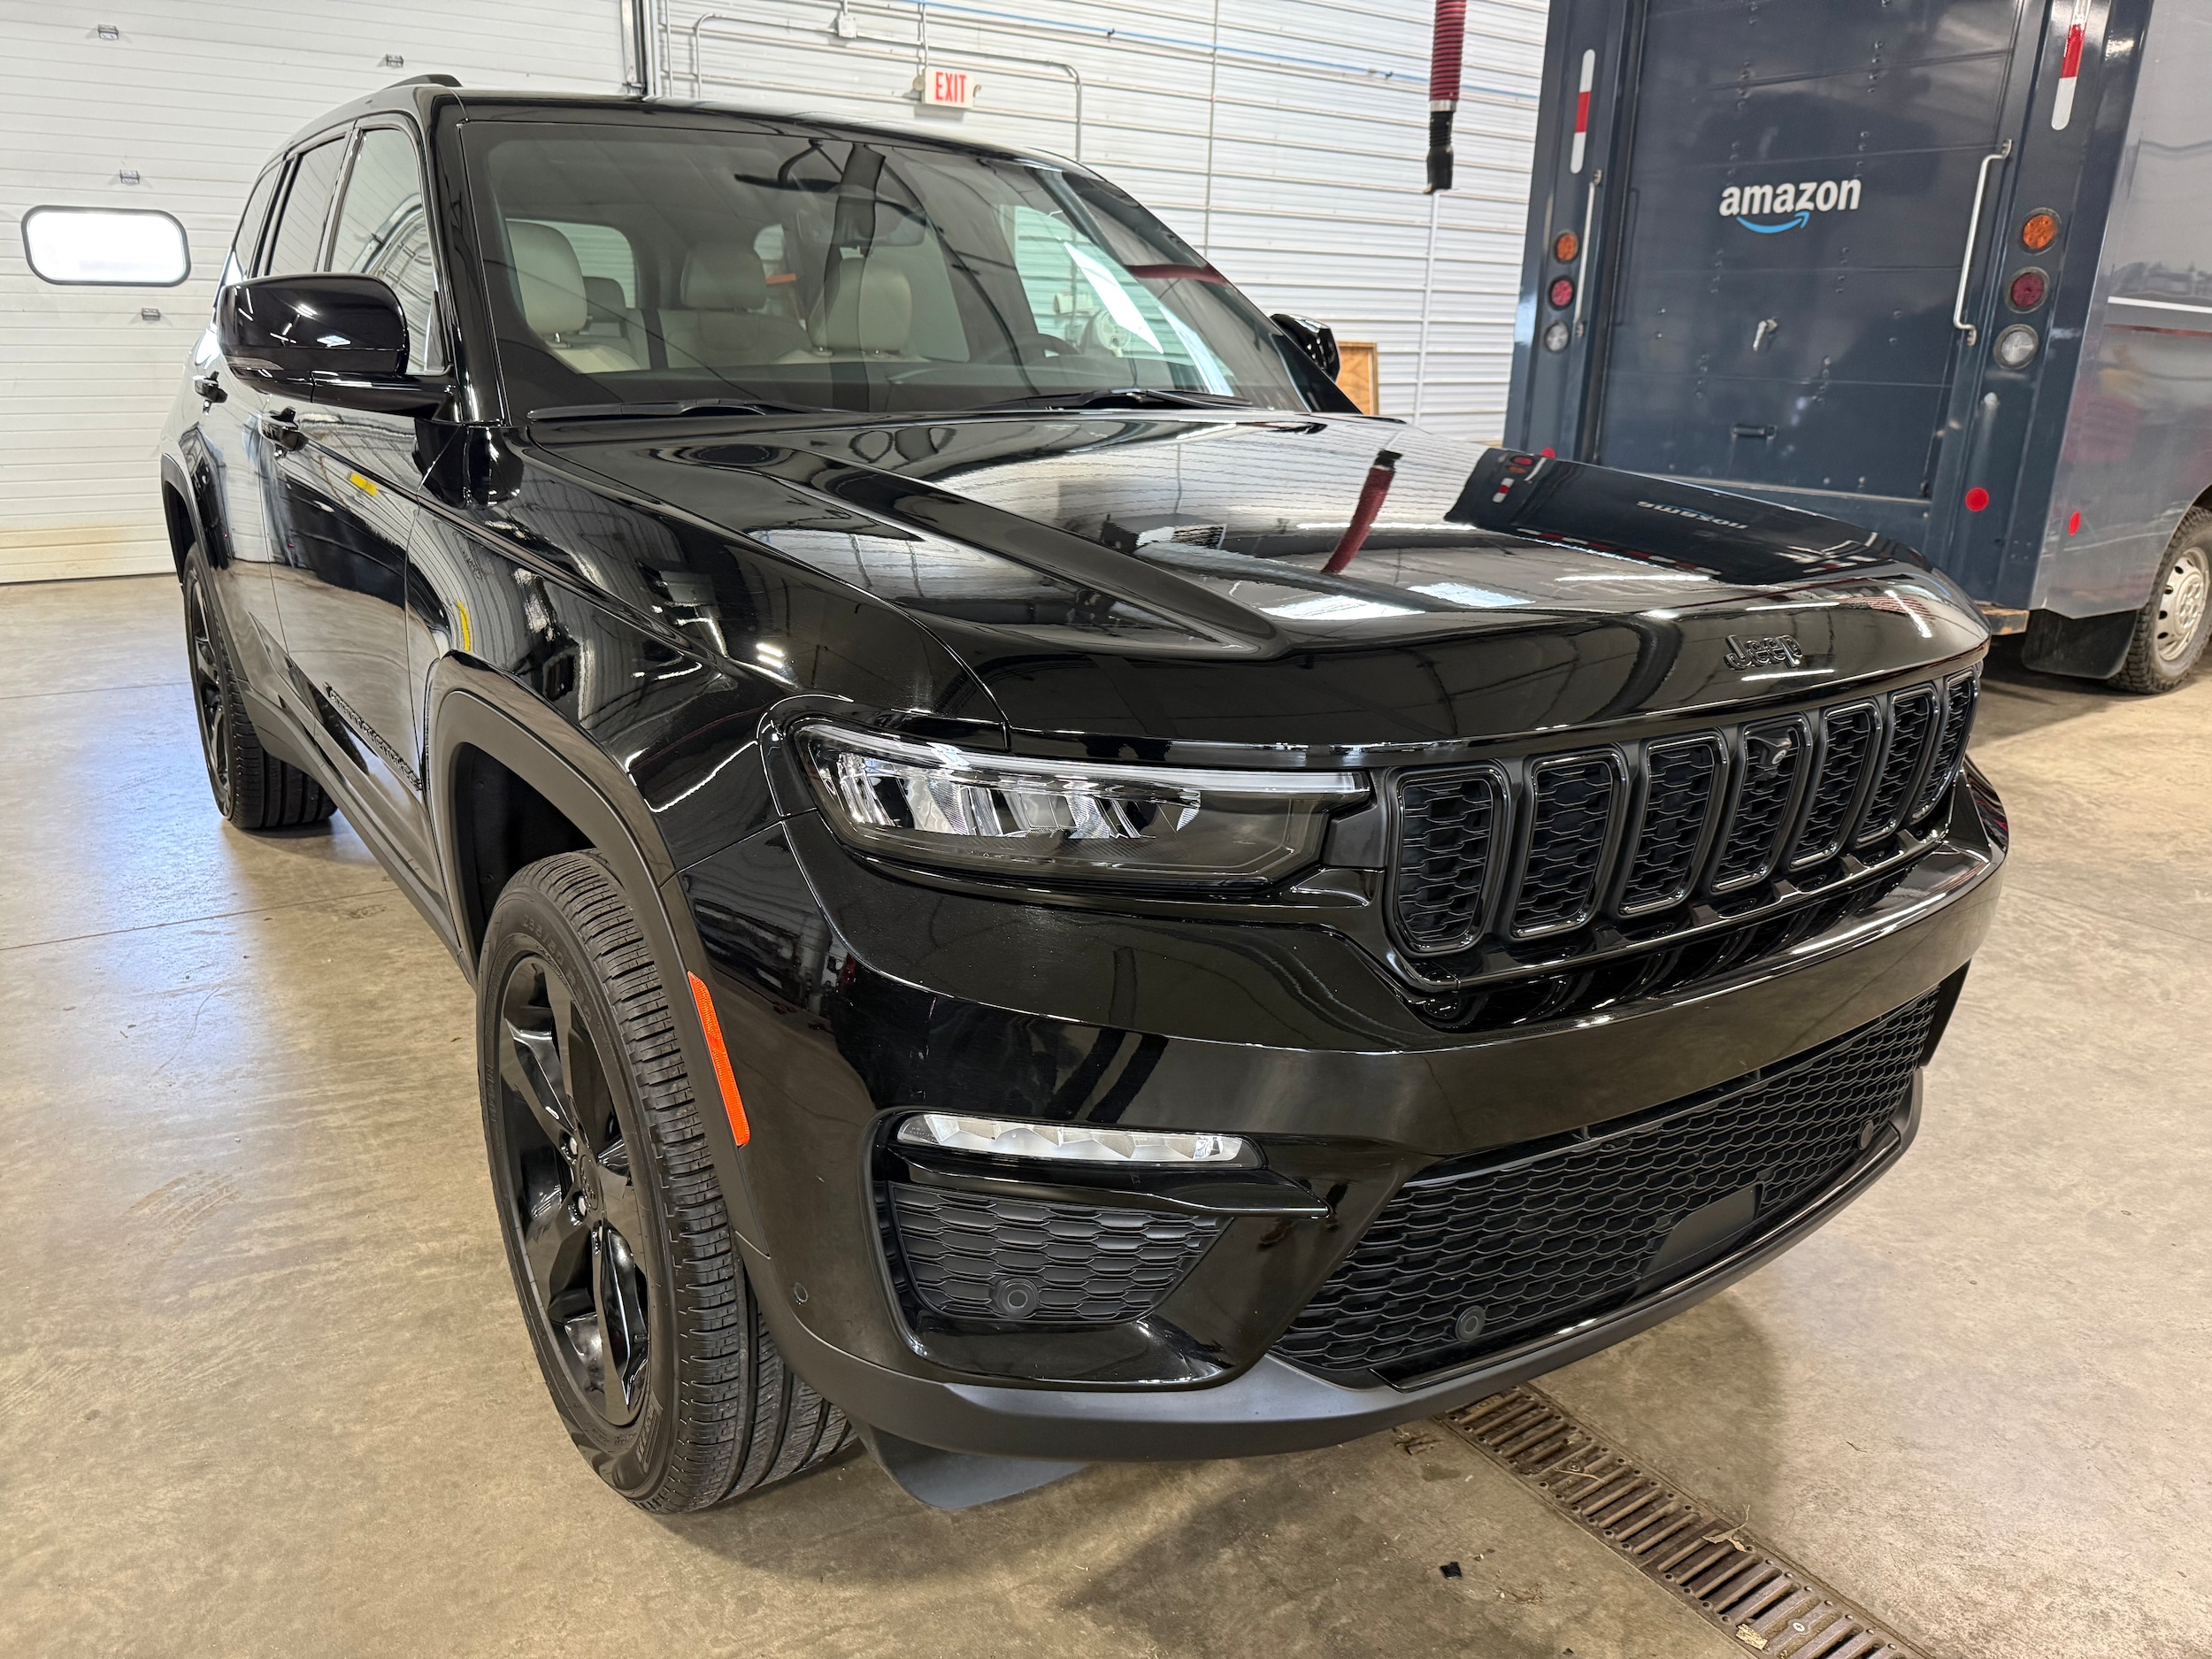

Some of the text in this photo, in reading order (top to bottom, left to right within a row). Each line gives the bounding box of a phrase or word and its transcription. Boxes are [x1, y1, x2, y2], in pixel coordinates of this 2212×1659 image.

[935, 72, 966, 103] EXIT
[1719, 179, 1862, 217] amazon
[1724, 634, 1803, 671] Jeep
